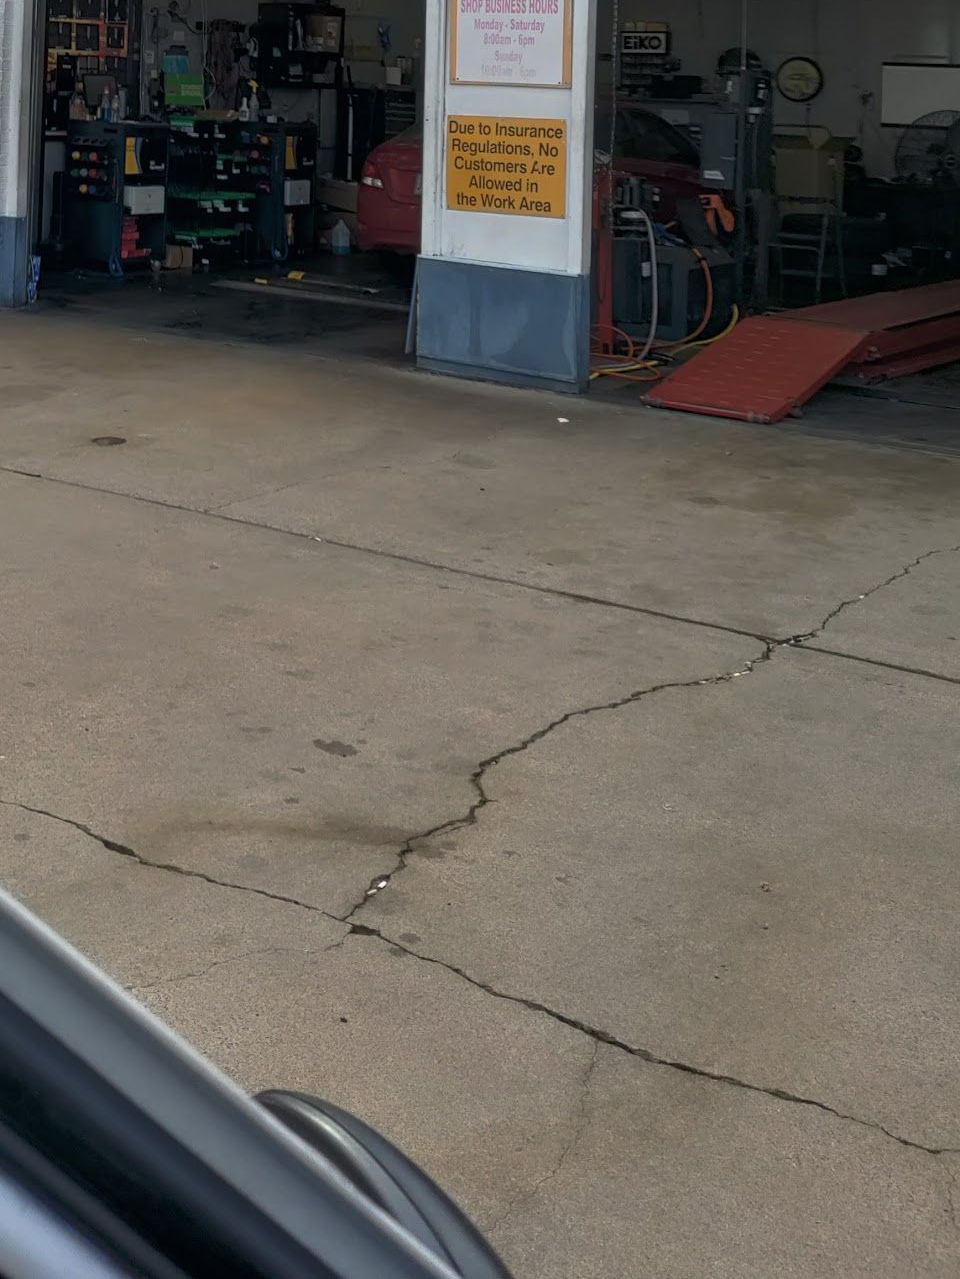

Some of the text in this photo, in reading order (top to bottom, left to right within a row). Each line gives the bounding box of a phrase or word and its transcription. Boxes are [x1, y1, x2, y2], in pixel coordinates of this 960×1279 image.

[474, 18, 504, 34] Monday
[510, 18, 545, 34] Saturday
[483, 32, 512, 45] 8:00am
[495, 50, 523, 65] Sunday
[448, 120, 563, 139] Due to Insurance
[451, 138, 559, 159] Regulations, No
[454, 156, 556, 176] Customers Are
[468, 175, 539, 193] Allowed in
[456, 192, 552, 213] the Work Area
